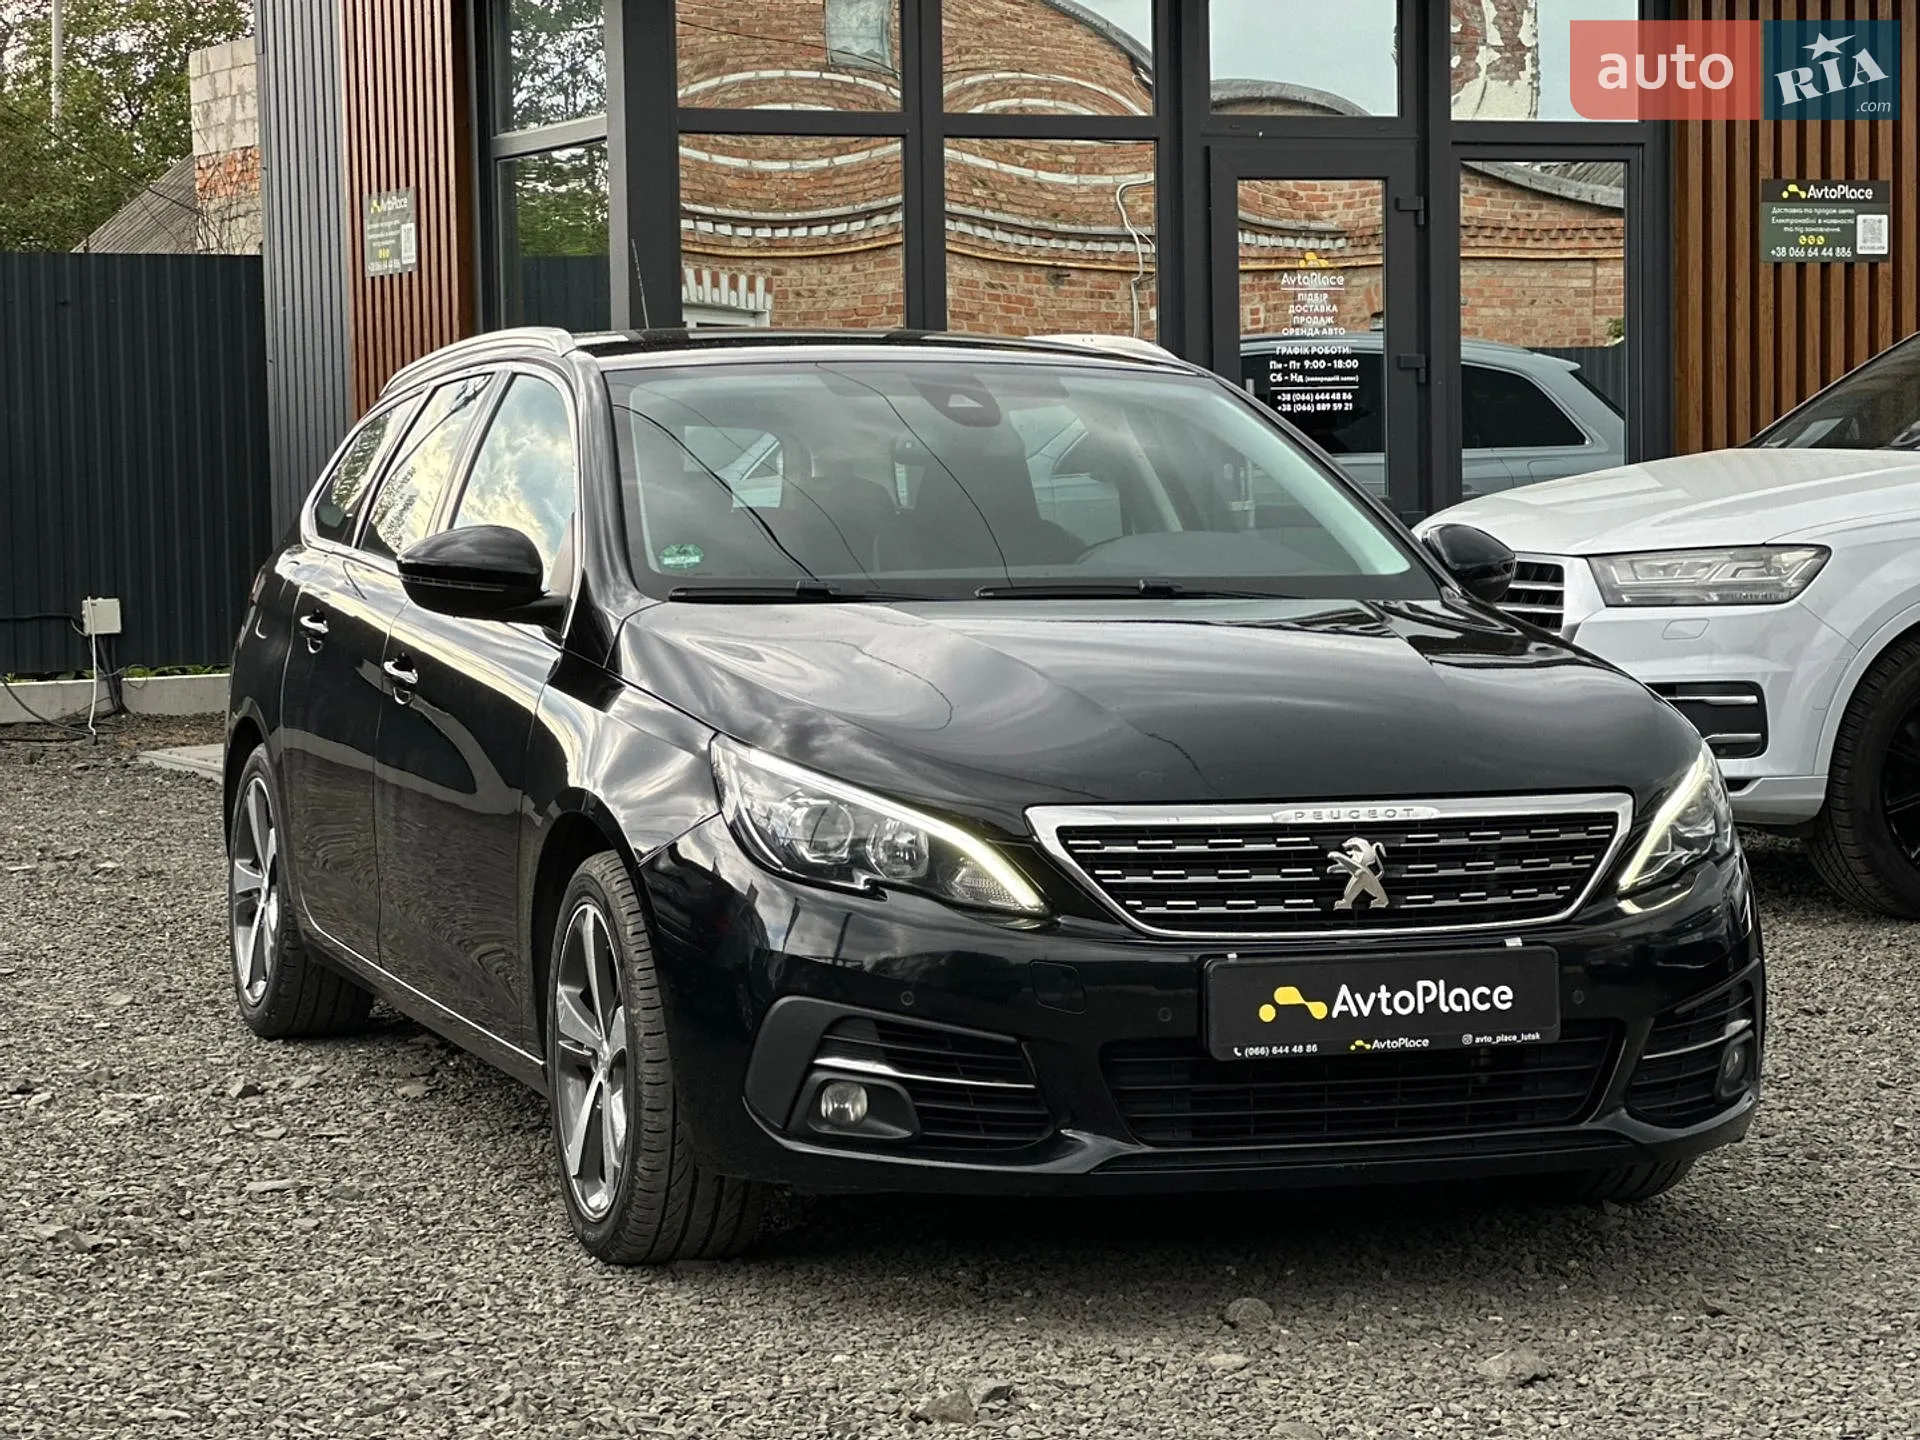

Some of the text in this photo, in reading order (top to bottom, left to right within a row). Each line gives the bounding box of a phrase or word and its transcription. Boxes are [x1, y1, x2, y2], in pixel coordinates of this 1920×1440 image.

[1808, 185, 1873, 199] AvtoPlace
[1771, 247, 1786, 257] +38
[1789, 247, 1805, 257] 066
[1807, 247, 1819, 257] 64
[1821, 246, 1832, 257] 44
[1835, 246, 1852, 257] 886
[1281, 272, 1344, 285] AvtoPlace
[1298, 293, 1328, 301] ПІДБІР
[1288, 304, 1338, 313] ДОСТАВКА
[1294, 316, 1334, 324] ПРОДАЖ
[1282, 328, 1346, 336] ОРЕНДА АВТО
[1276, 346, 1310, 355] ГРАФІК
[1270, 361, 1282, 369] Пн
[1289, 360, 1301, 369] Пт
[1304, 359, 1326, 369] 9:00
[1333, 359, 1358, 369] 18:00
[1270, 373, 1282, 382] Сб
[1290, 372, 1304, 382] Нд
[1292, 393, 1314, 402] (066)
[1293, 403, 1314, 413] (066)
[1344, 402, 1353, 410] 21
[1294, 808, 1414, 820] PEUGEOT
[1332, 979, 1513, 1018] AvtoPlace
[1372, 1038, 1430, 1049] AvtoPlace
[1475, 1032, 1541, 1044] avto_place_lutsk
[1244, 1044, 1318, 1057] (066) 644 48 86
